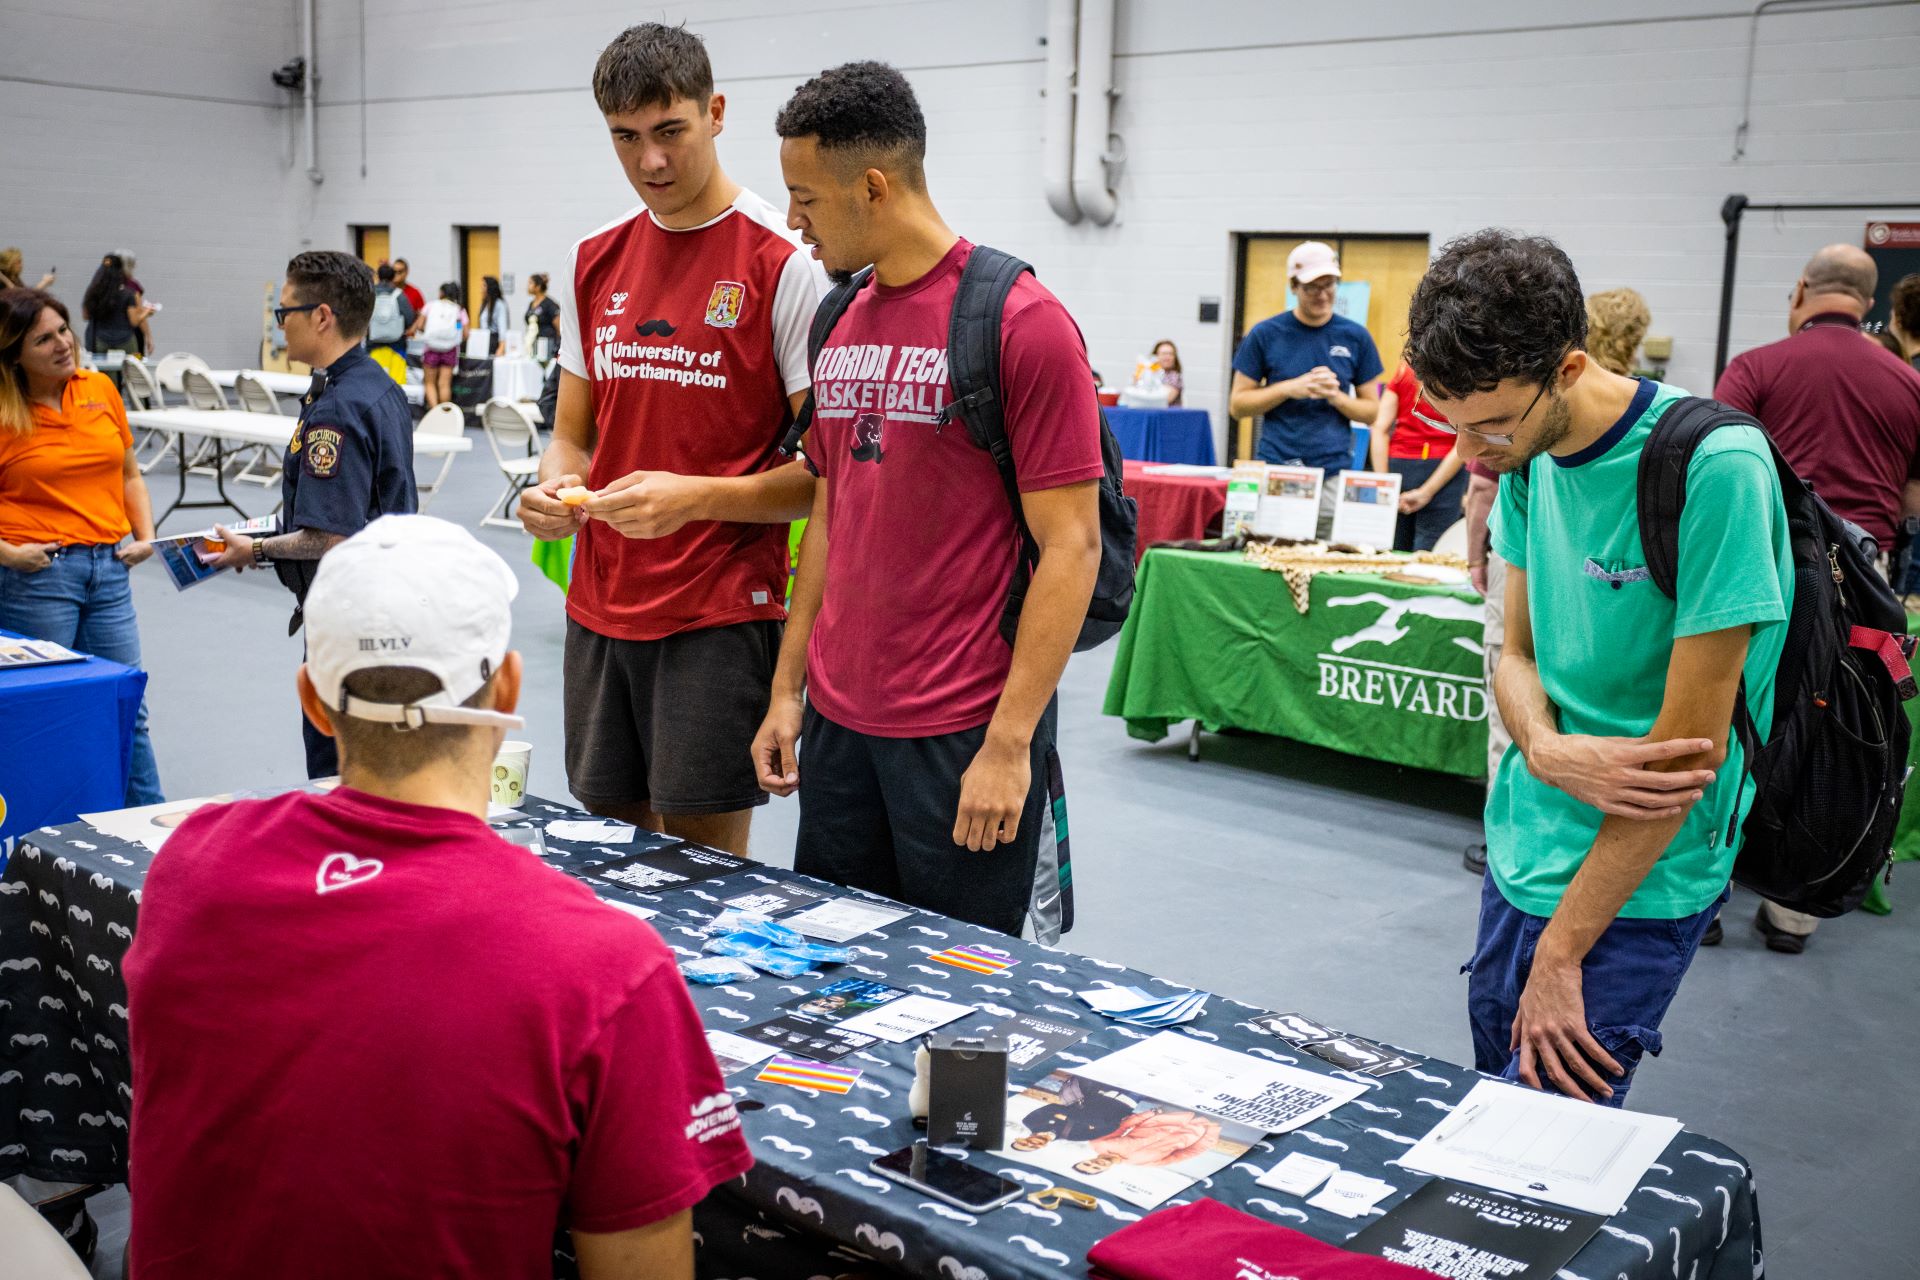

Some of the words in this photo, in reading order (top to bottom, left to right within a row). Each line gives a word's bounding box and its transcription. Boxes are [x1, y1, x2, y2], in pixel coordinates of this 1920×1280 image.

[613, 342, 696, 367] University
[699, 350, 721, 367] of
[613, 360, 727, 389] Northampton
[307, 428, 342, 445] SECURITY
[1317, 661, 1488, 722] BREVARD
[1261, 1089, 1322, 1109] MEN'S
[1266, 1081, 1333, 1103] HEALTH
[1213, 1093, 1298, 1121] KNOWING
[1219, 1104, 1284, 1127] WORTH
[1249, 1095, 1311, 1115] ABOUT
[1453, 1191, 1498, 1207] DONATE
[1502, 1204, 1518, 1213] OR
[1445, 1195, 1568, 1231] MOVEMBER.COM
[1522, 1210, 1538, 1219] UP
[1543, 1214, 1572, 1226] SIGN
[1475, 1250, 1529, 1271] HEALTH
